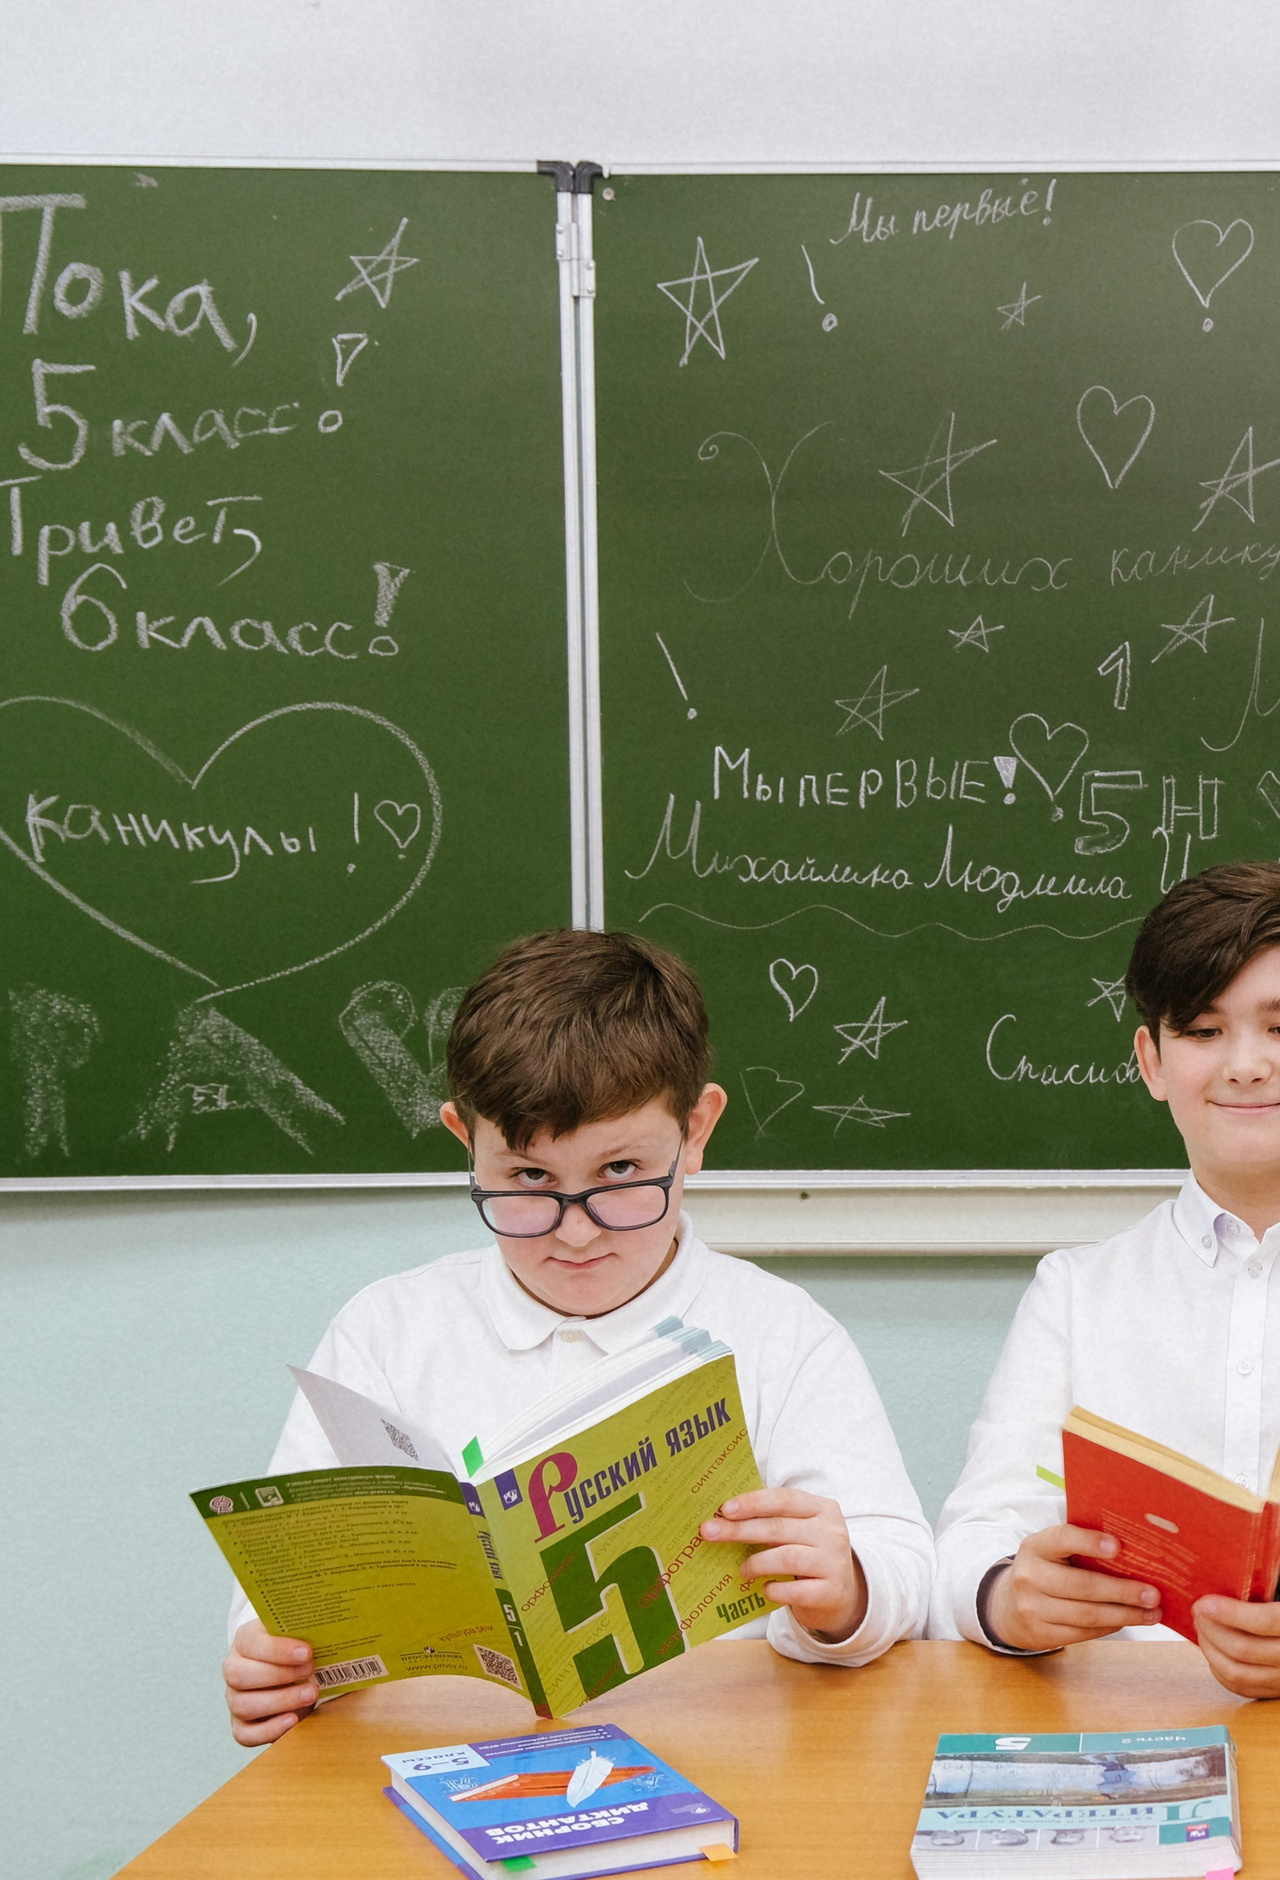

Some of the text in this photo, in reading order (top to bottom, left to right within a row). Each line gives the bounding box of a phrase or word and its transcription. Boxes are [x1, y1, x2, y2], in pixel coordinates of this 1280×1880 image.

[830, 191, 899, 244] Мы
[18, 358, 97, 470] 5
[684, 420, 1074, 620] Хороших
[716, 1592, 767, 1623] Часть
[485, 1802, 649, 1836] ДИКТАНТОВ
[496, 1817, 626, 1845] СБОРНИК
